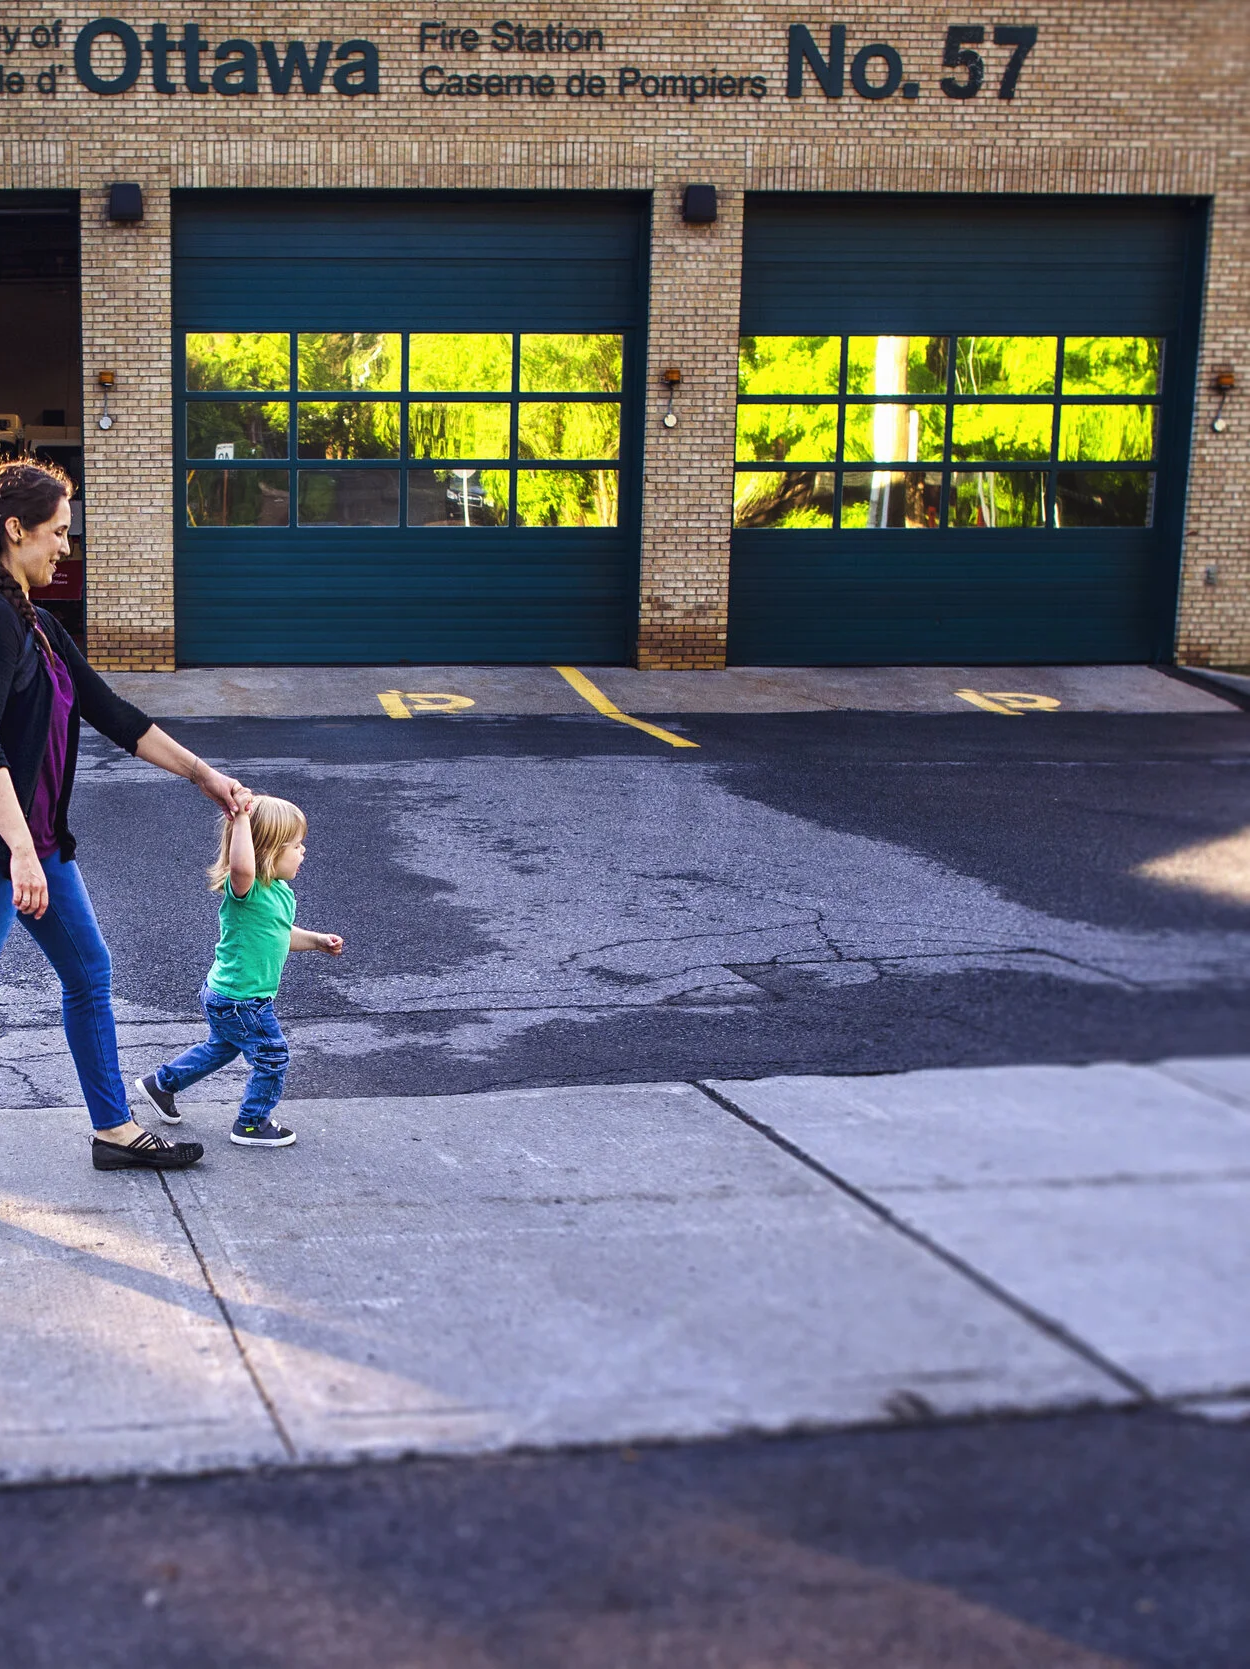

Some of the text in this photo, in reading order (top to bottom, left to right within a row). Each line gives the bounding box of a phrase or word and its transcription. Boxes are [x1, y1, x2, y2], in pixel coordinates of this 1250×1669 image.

[31, 19, 63, 50] of
[419, 20, 604, 53] Fire Station
[73, 17, 380, 96] Ottawa
[786, 24, 1038, 99] No. 57
[37, 64, 66, 95] d'
[419, 64, 768, 104] Caserne de Pompiers
